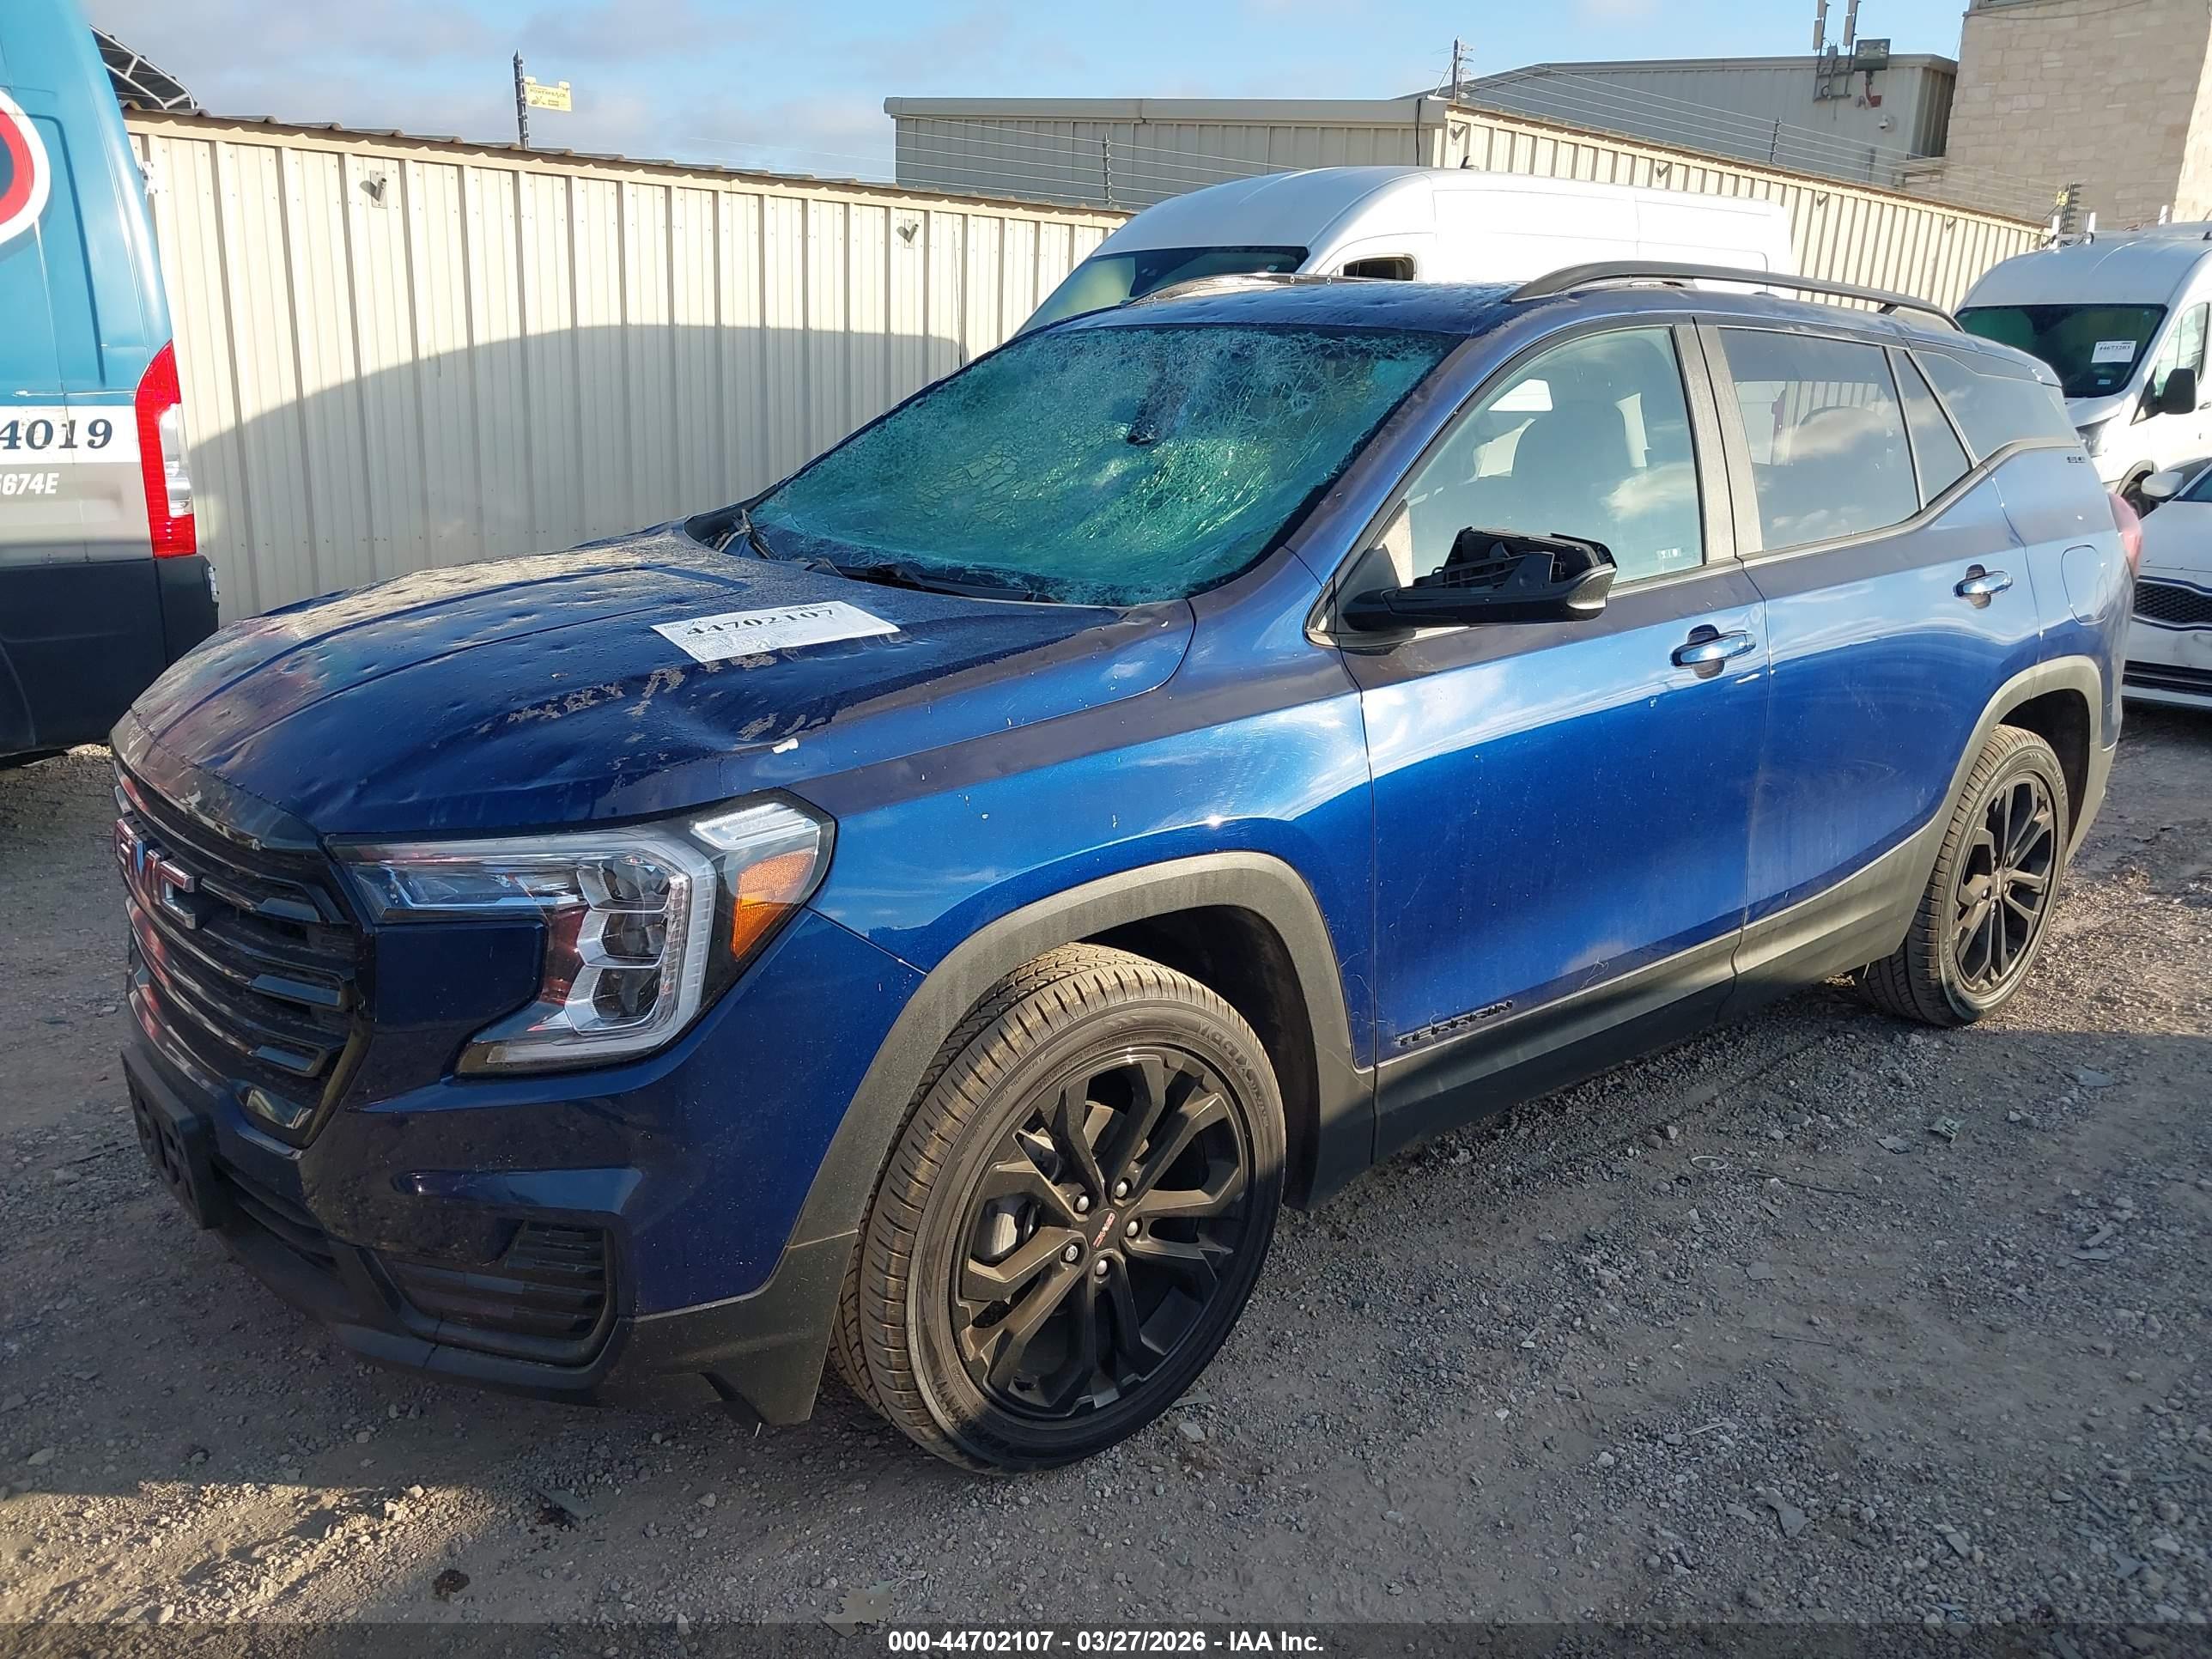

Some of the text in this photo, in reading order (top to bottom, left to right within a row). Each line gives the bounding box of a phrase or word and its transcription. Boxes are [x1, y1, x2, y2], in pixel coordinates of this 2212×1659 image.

[0, 418, 112, 450] 4019
[0, 472, 60, 495] 674E
[687, 609, 834, 636] 44702107
[1092, 1212, 1115, 1249] GMC
